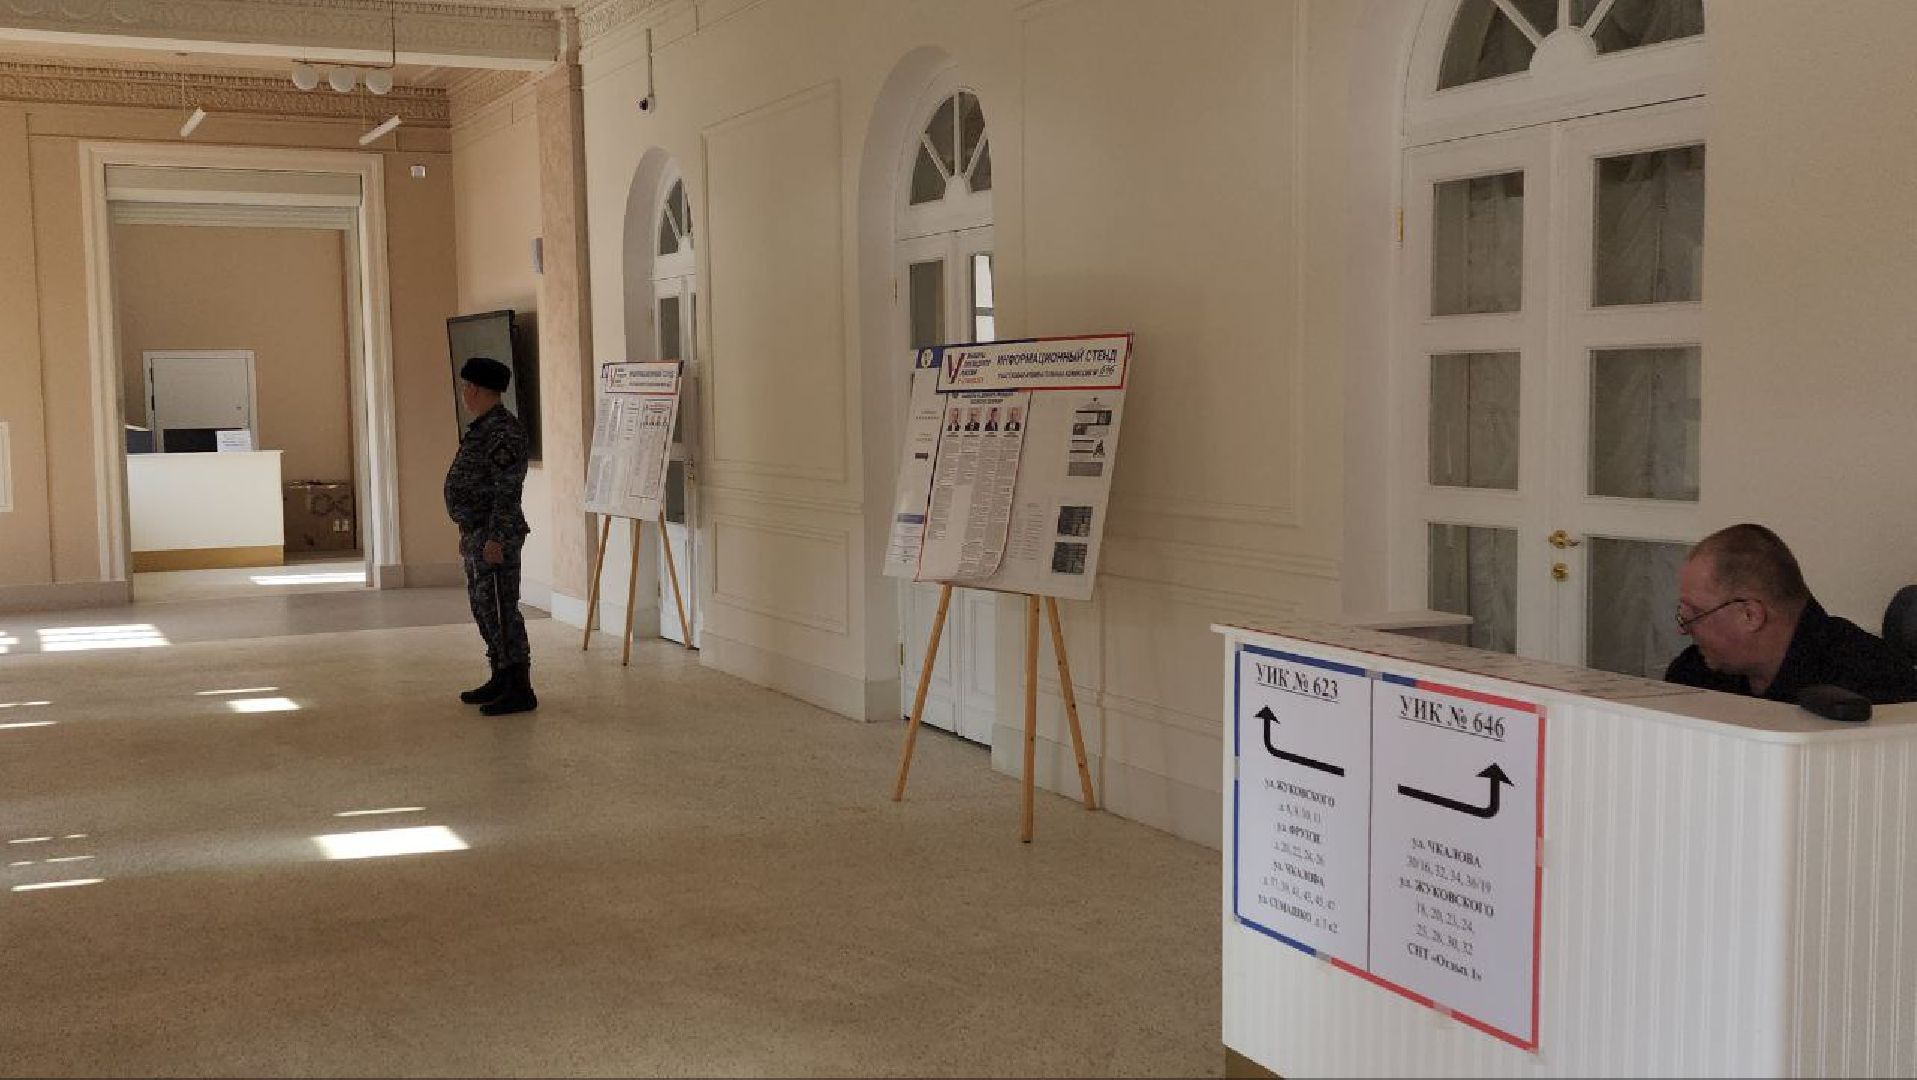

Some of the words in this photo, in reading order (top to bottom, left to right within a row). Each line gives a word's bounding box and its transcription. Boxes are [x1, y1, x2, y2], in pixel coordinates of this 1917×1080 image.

[997, 348, 1084, 365] ИНФОРМАЦИОННЫЙ
[1086, 348, 1117, 363] СТЕНД
[1256, 662, 1290, 688] УИК
[1292, 671, 1309, 693] №
[1313, 676, 1339, 699] 623
[1400, 695, 1443, 724] УИК
[1447, 705, 1468, 730] №
[1473, 712, 1506, 739] 646
[1276, 778, 1335, 808] ЖУКОВСКОГО
[1427, 839, 1482, 869] ЧКАЛОВА
[1285, 862, 1325, 888] ЧКАЛОВА
[1269, 896, 1312, 923] СЕМАШКО
[1415, 877, 1494, 919] ЖУКОВСКОГО
[1408, 942, 1428, 961] СНТ
